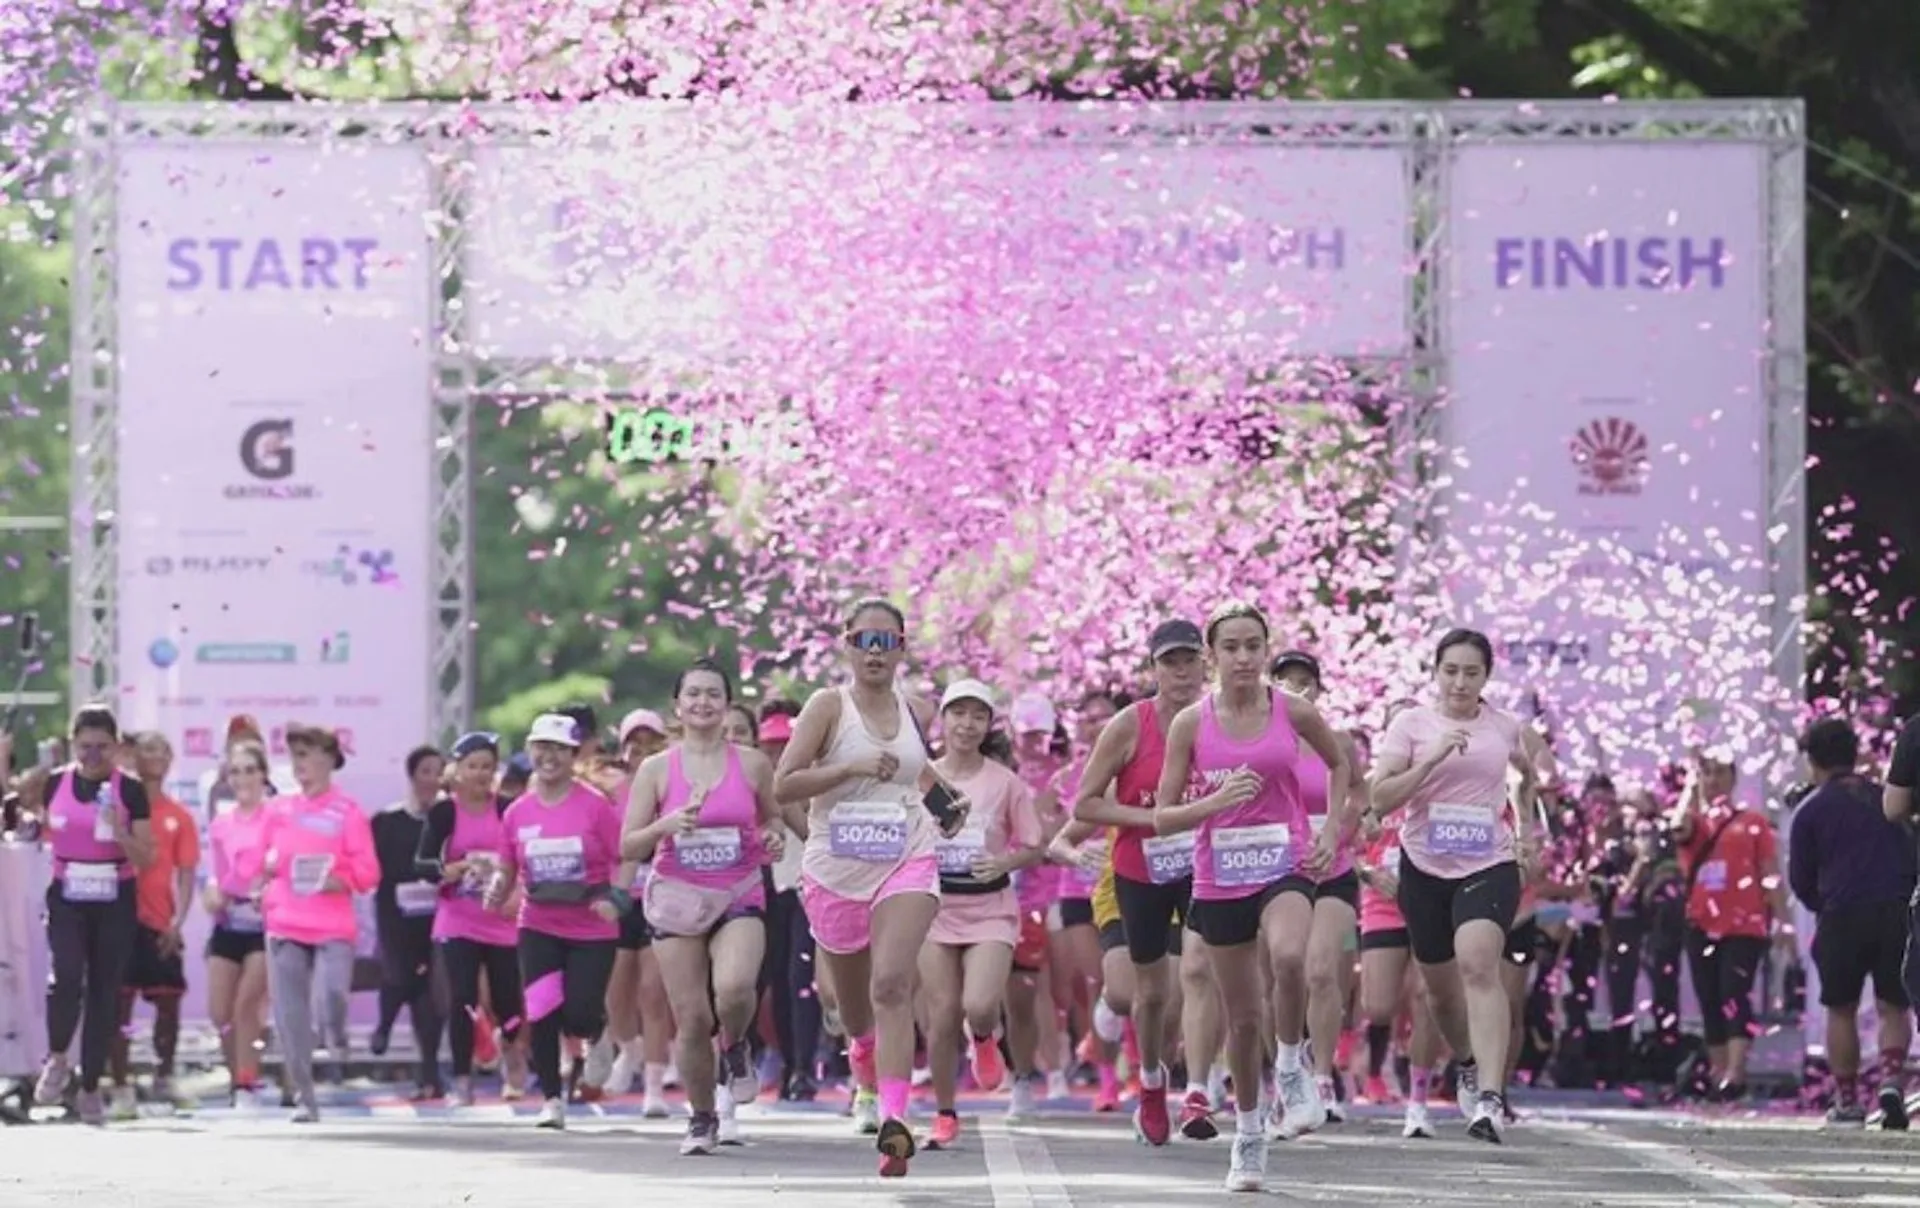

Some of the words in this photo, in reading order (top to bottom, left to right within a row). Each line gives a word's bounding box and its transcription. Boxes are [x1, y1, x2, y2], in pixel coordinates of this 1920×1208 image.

[166, 238, 380, 290] START
[1495, 236, 1726, 289] FINISH
[239, 417, 294, 480] G
[837, 824, 900, 843] 50260
[680, 845, 736, 865] 50303
[1221, 845, 1284, 869] 50867
